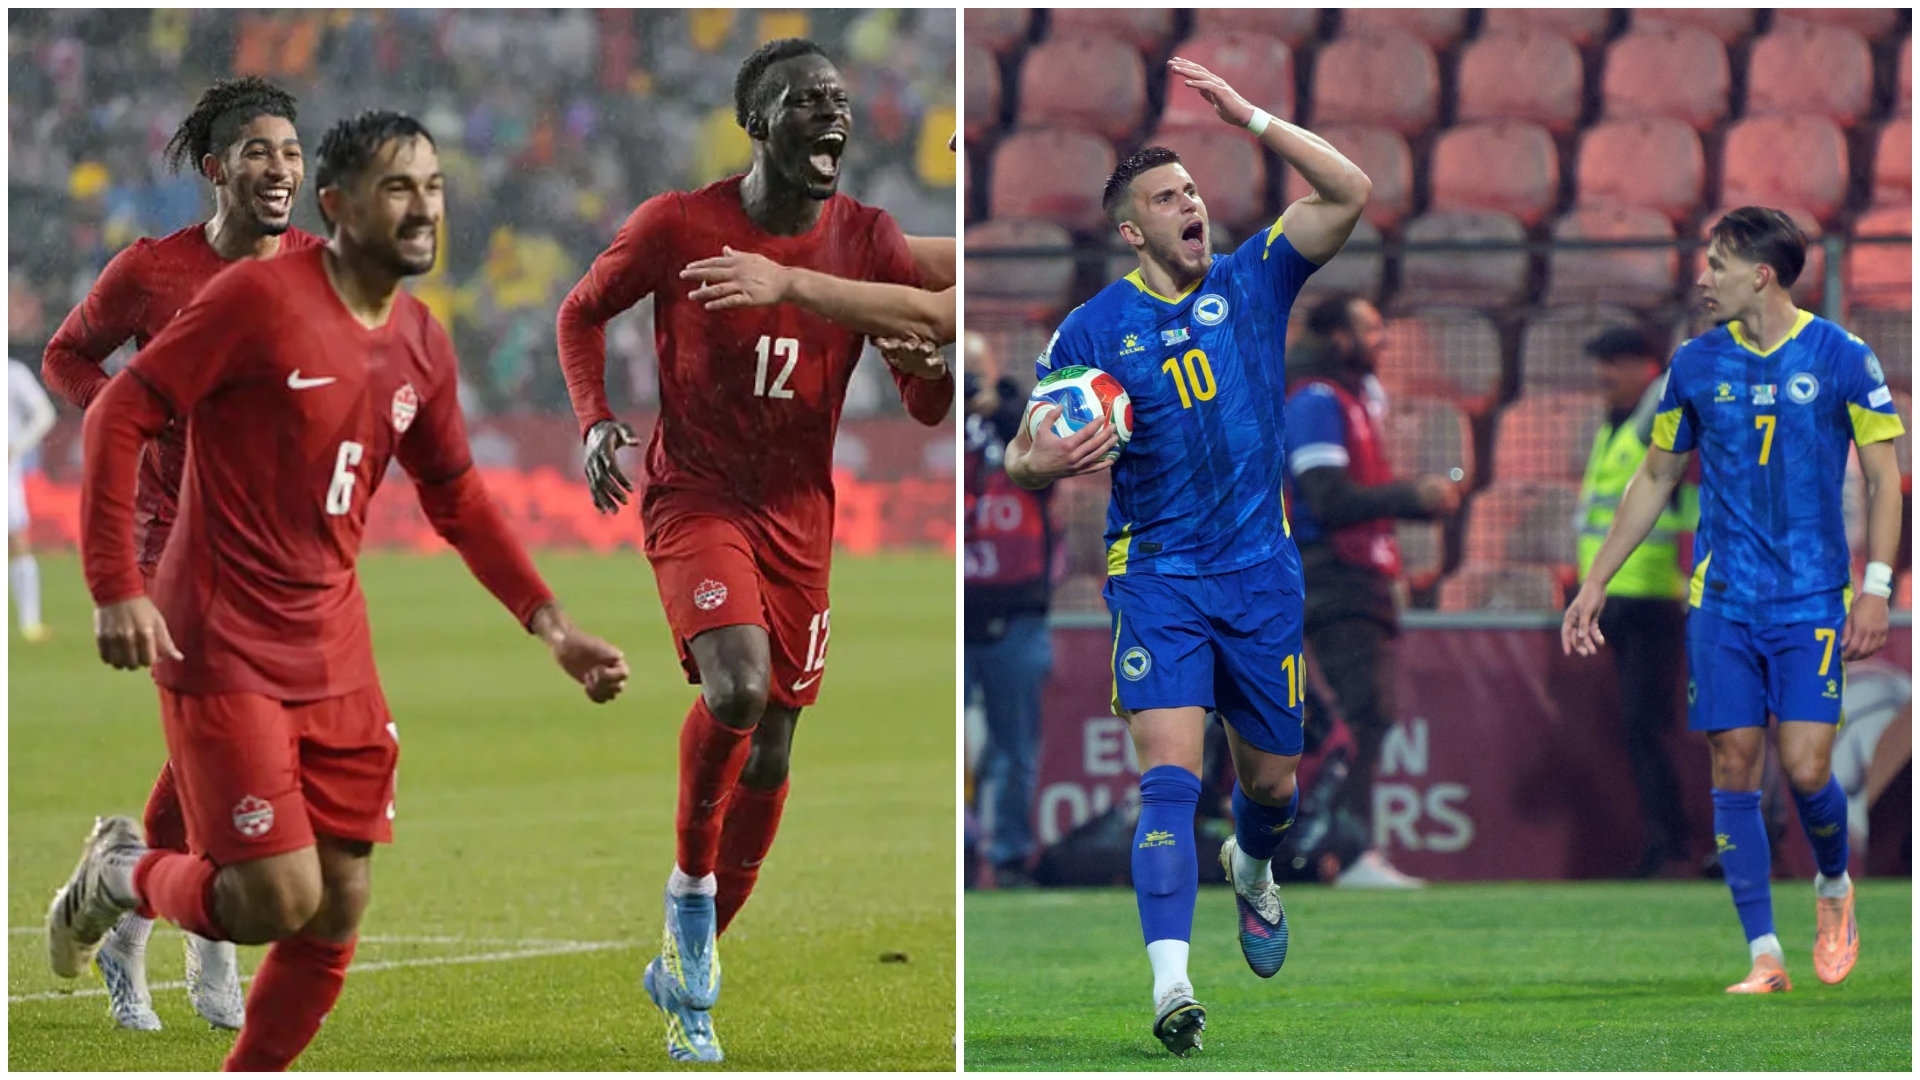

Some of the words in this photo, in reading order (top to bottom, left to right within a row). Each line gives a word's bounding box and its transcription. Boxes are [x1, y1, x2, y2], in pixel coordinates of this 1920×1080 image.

[754, 335, 799, 400] 12
[1120, 345, 1146, 356] KELME
[1162, 349, 1217, 409] 10
[1755, 415, 1776, 466] 7
[326, 440, 364, 514] 6
[804, 608, 831, 673] 12
[1815, 628, 1836, 676] 7
[1281, 652, 1306, 708] 10
[1138, 839, 1176, 849] KELME
